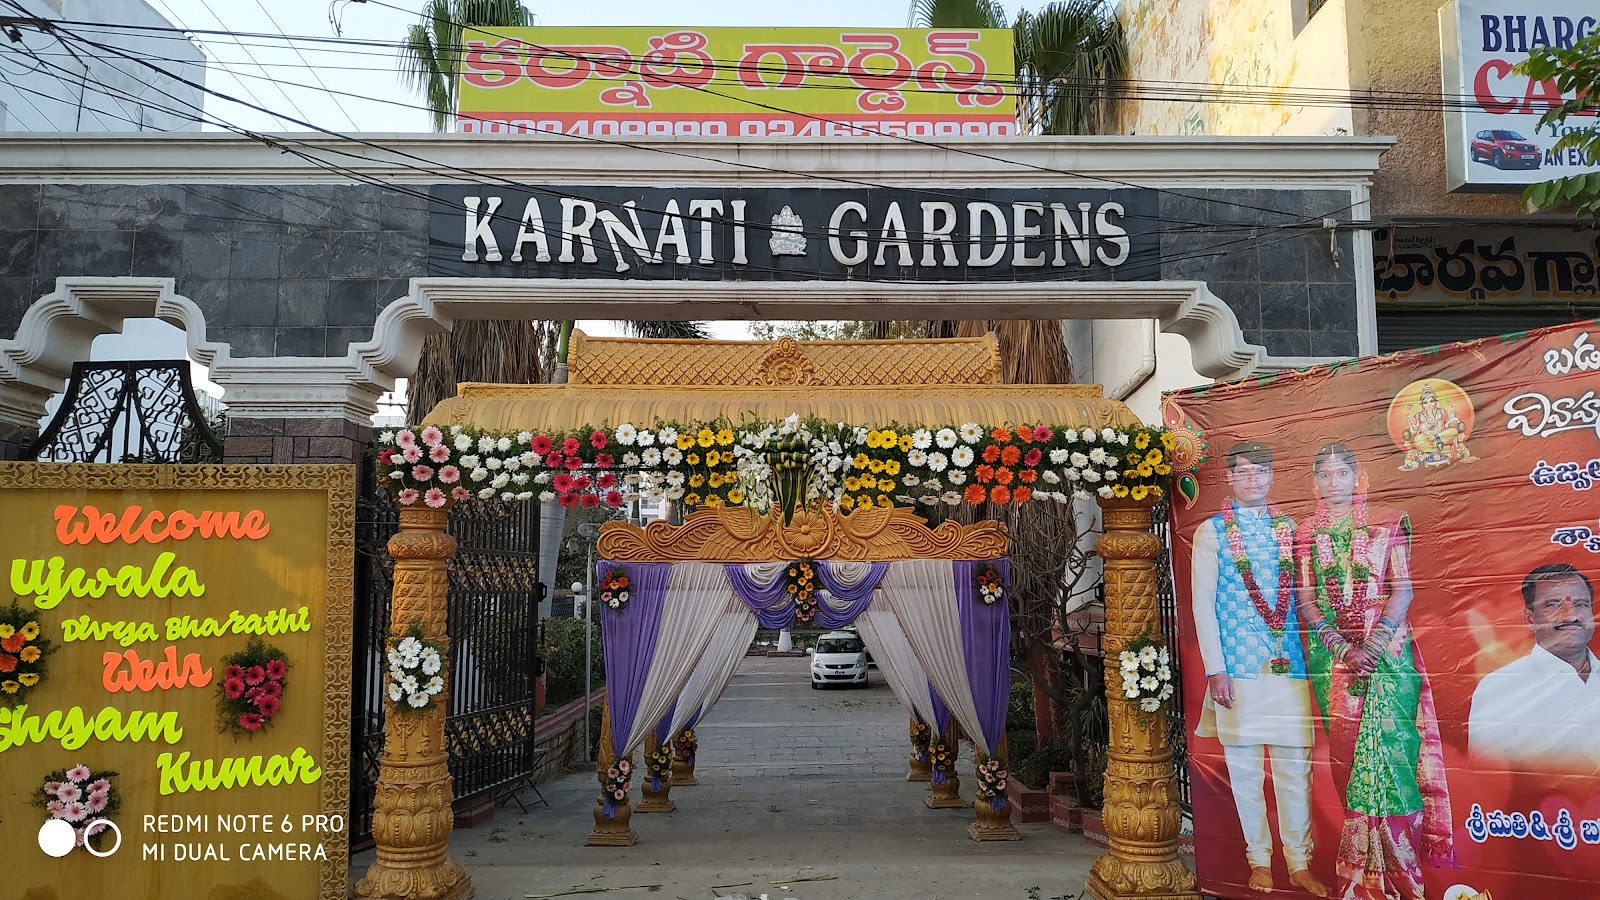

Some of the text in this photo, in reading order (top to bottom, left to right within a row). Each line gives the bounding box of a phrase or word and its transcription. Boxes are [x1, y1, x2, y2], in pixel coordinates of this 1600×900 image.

[1480, 14, 1600, 53] BHARG
[461, 30, 1005, 113] కర్నాటి గార్డెన్స్
[1544, 148, 1564, 166] AN
[461, 196, 1131, 273] KARNATI GARDENS
[54, 504, 270, 545] Welcome
[61, 606, 311, 647] Divya Bharathi
[102, 645, 213, 693] Weds
[0, 703, 183, 752] Shyam
[156, 746, 322, 795] Kumar
